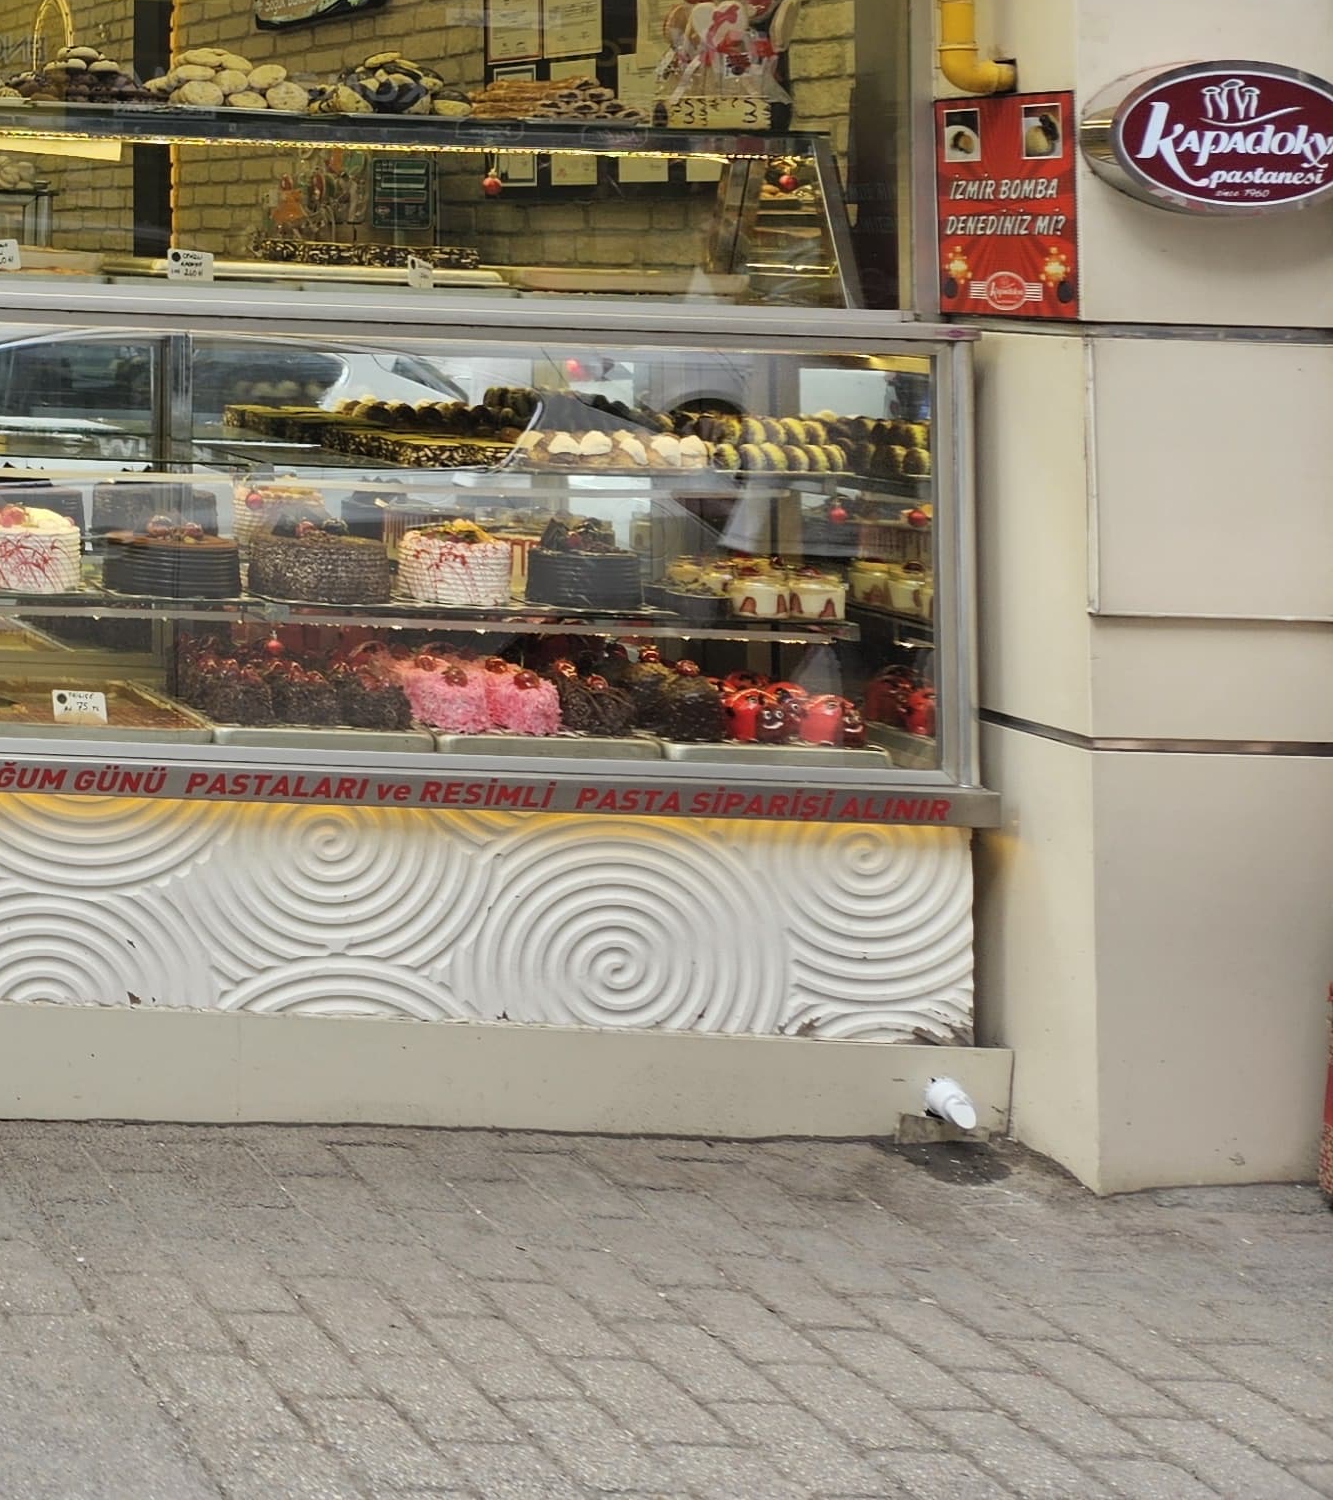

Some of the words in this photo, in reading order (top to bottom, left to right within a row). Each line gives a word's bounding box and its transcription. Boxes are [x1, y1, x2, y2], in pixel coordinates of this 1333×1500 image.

[948, 173, 995, 201] İZMİR
[999, 176, 1059, 199] BOMBA
[1208, 167, 1326, 189] pastanesi
[945, 208, 1031, 237] DENEDİNİZ
[73, 765, 168, 795] GÜNÜ
[185, 772, 370, 800] PASTALARI
[377, 783, 413, 802] ve
[419, 778, 558, 809] RESİMLİ
[574, 786, 682, 813] PASTA
[689, 786, 838, 821] SİPARİŞİ
[838, 796, 953, 821] ALINIR
